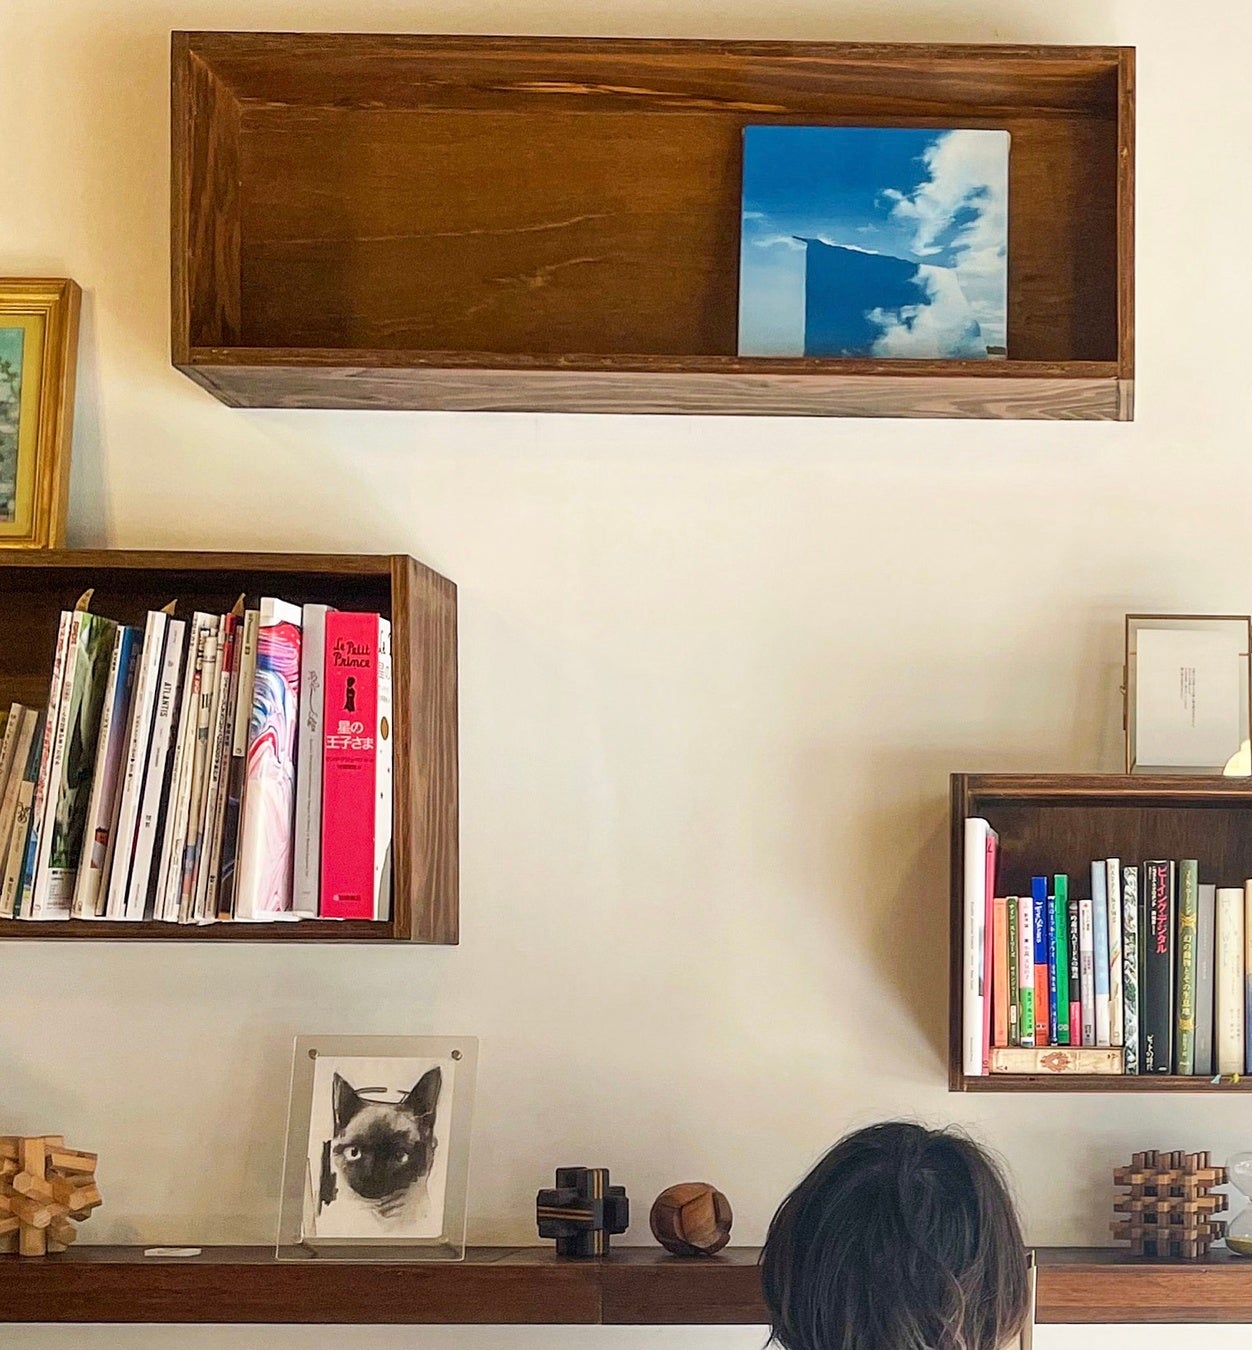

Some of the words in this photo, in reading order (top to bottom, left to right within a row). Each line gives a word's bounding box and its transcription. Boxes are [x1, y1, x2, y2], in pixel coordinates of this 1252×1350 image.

[346, 641, 371, 656] Petit
[333, 652, 371, 668] Prince
[159, 681, 172, 718] ATLANTIS
[337, 720, 364, 734] 星の
[326, 735, 374, 750] 王子さま
